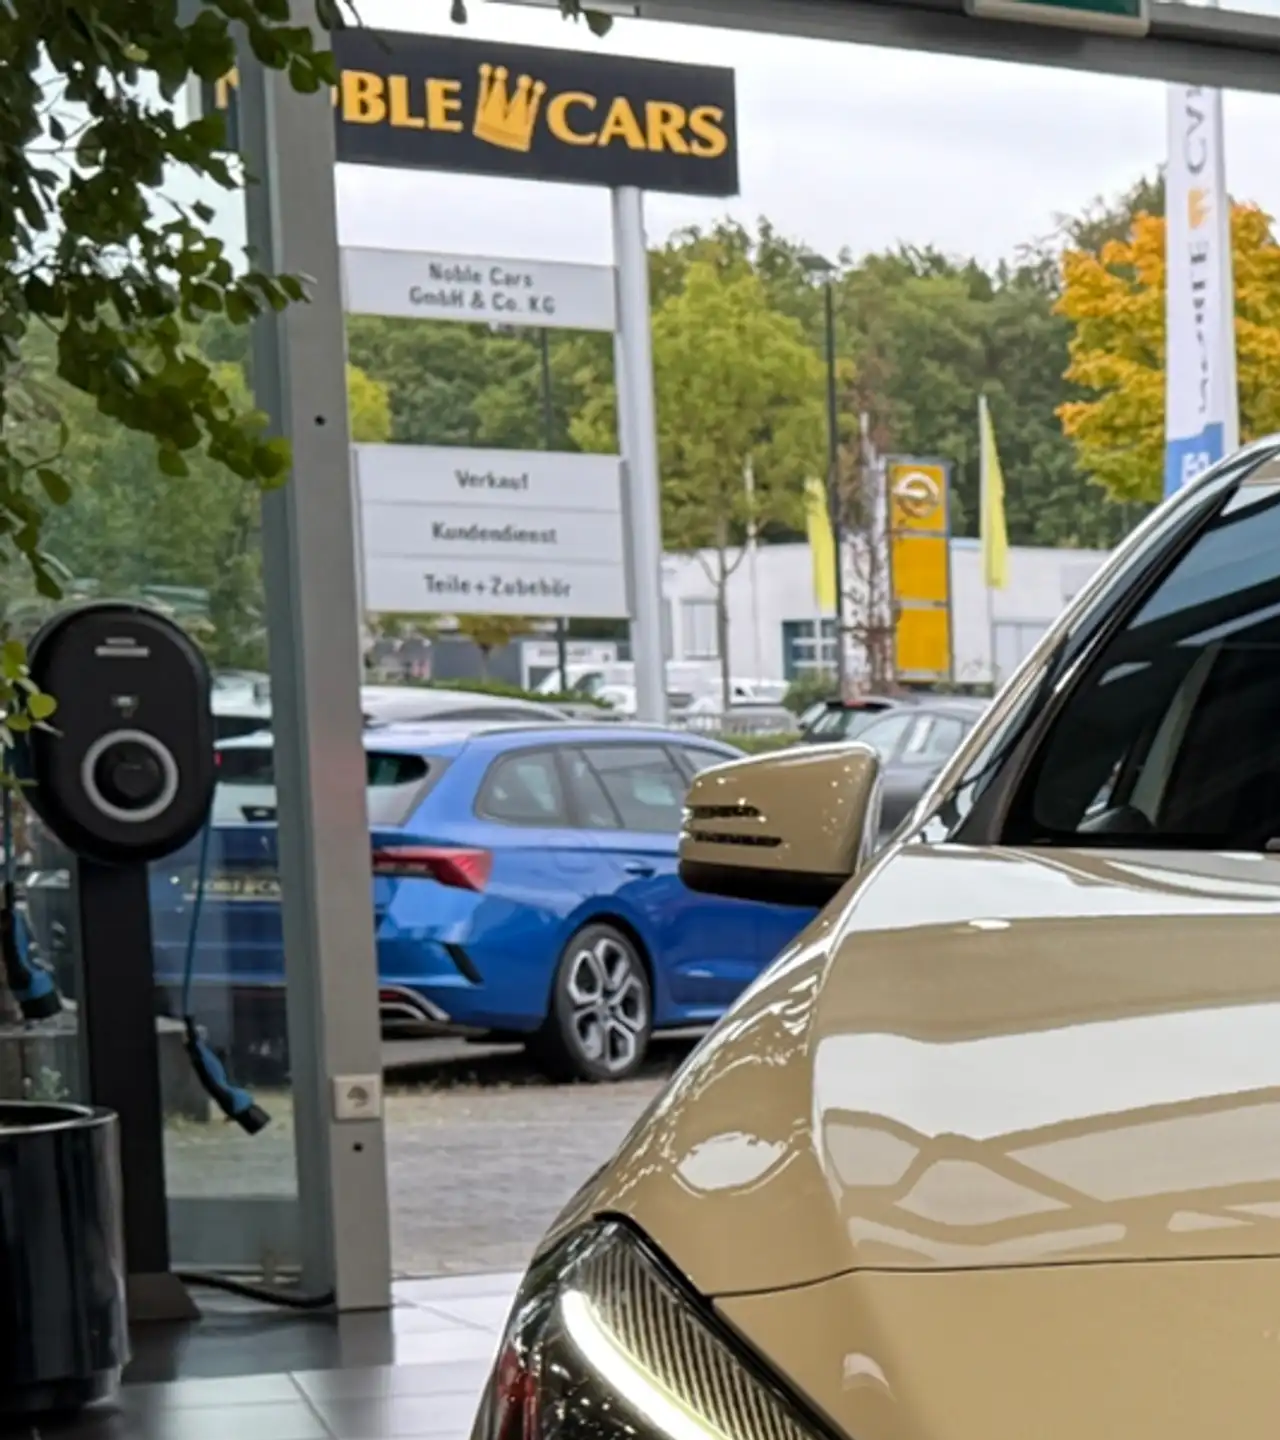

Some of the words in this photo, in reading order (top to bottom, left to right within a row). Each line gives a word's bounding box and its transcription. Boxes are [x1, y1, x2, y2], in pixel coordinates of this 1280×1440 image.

[547, 90, 728, 158] CARS
[429, 263, 481, 284] Noble
[489, 266, 533, 288] Cars
[409, 286, 463, 308] GmbH
[470, 290, 486, 310] &
[492, 292, 522, 312] Co.
[528, 295, 556, 315] KG
[455, 469, 529, 491] Verkauf
[432, 521, 557, 544] Kundendienst
